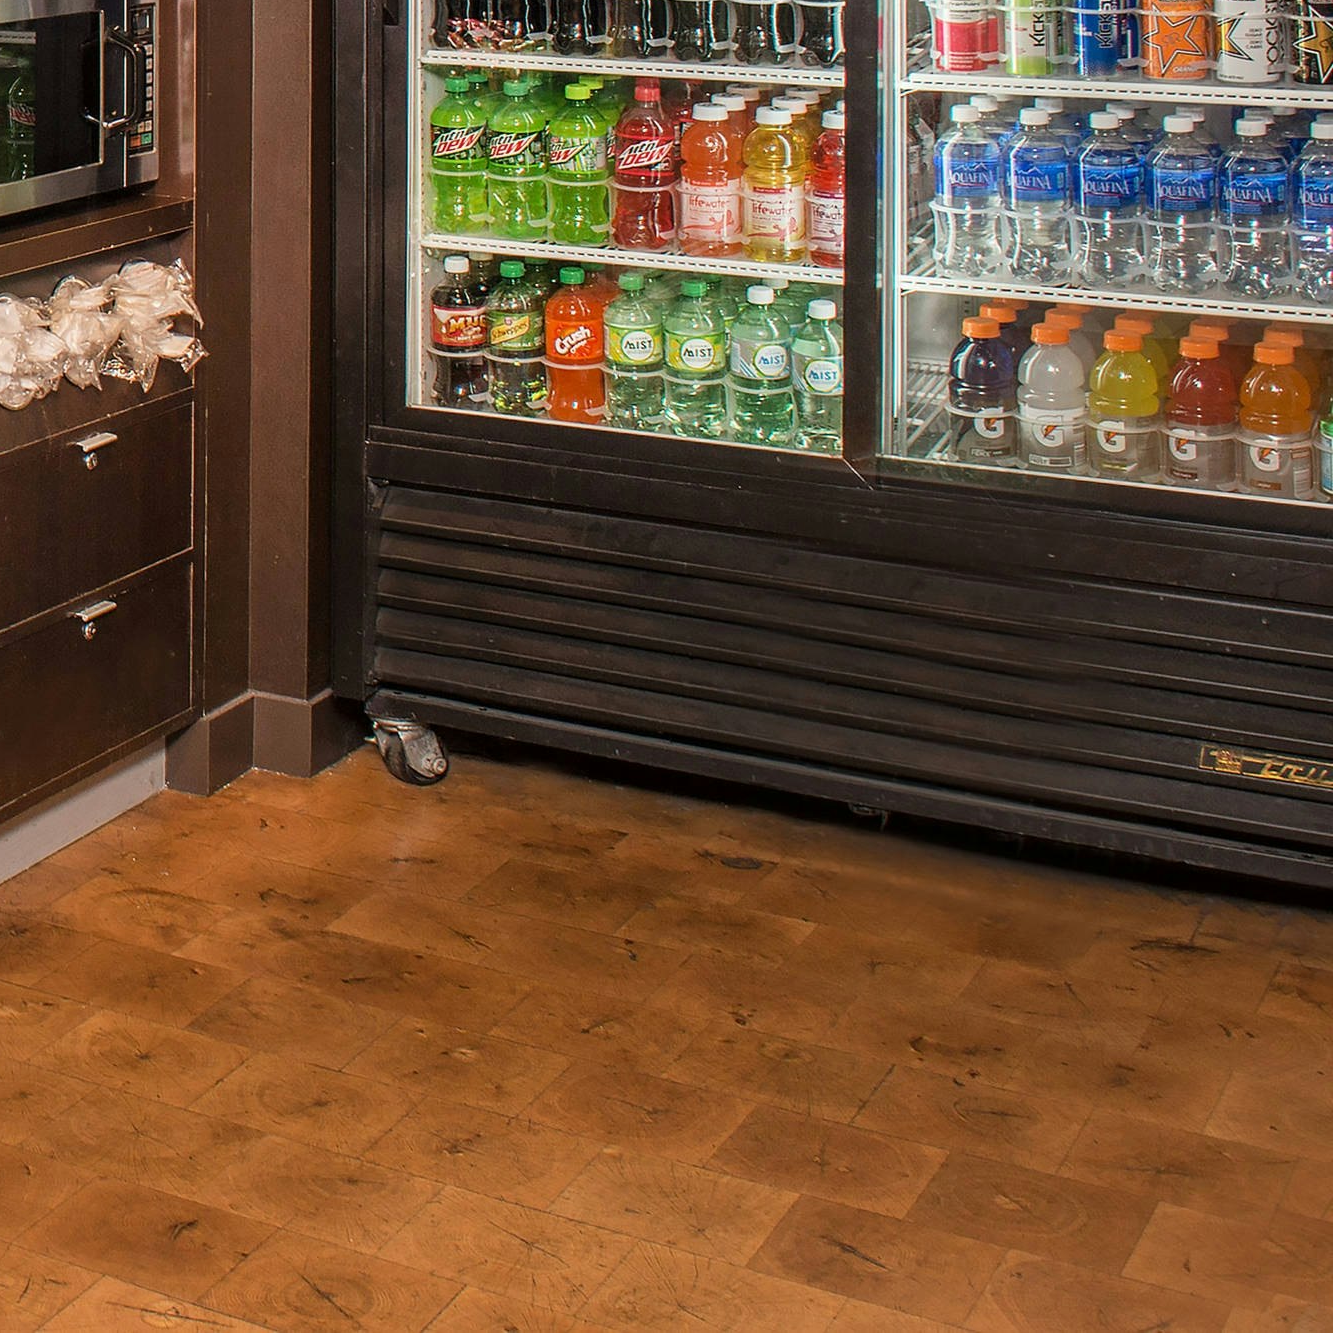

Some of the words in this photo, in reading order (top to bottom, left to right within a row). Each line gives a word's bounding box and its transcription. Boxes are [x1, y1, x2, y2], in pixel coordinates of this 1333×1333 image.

[436, 131, 481, 154] DEW
[623, 143, 670, 165] DEW
[1156, 183, 1206, 199] AQUAFINA
[1222, 186, 1273, 204] AQUAFINA
[555, 326, 591, 355] Crush
